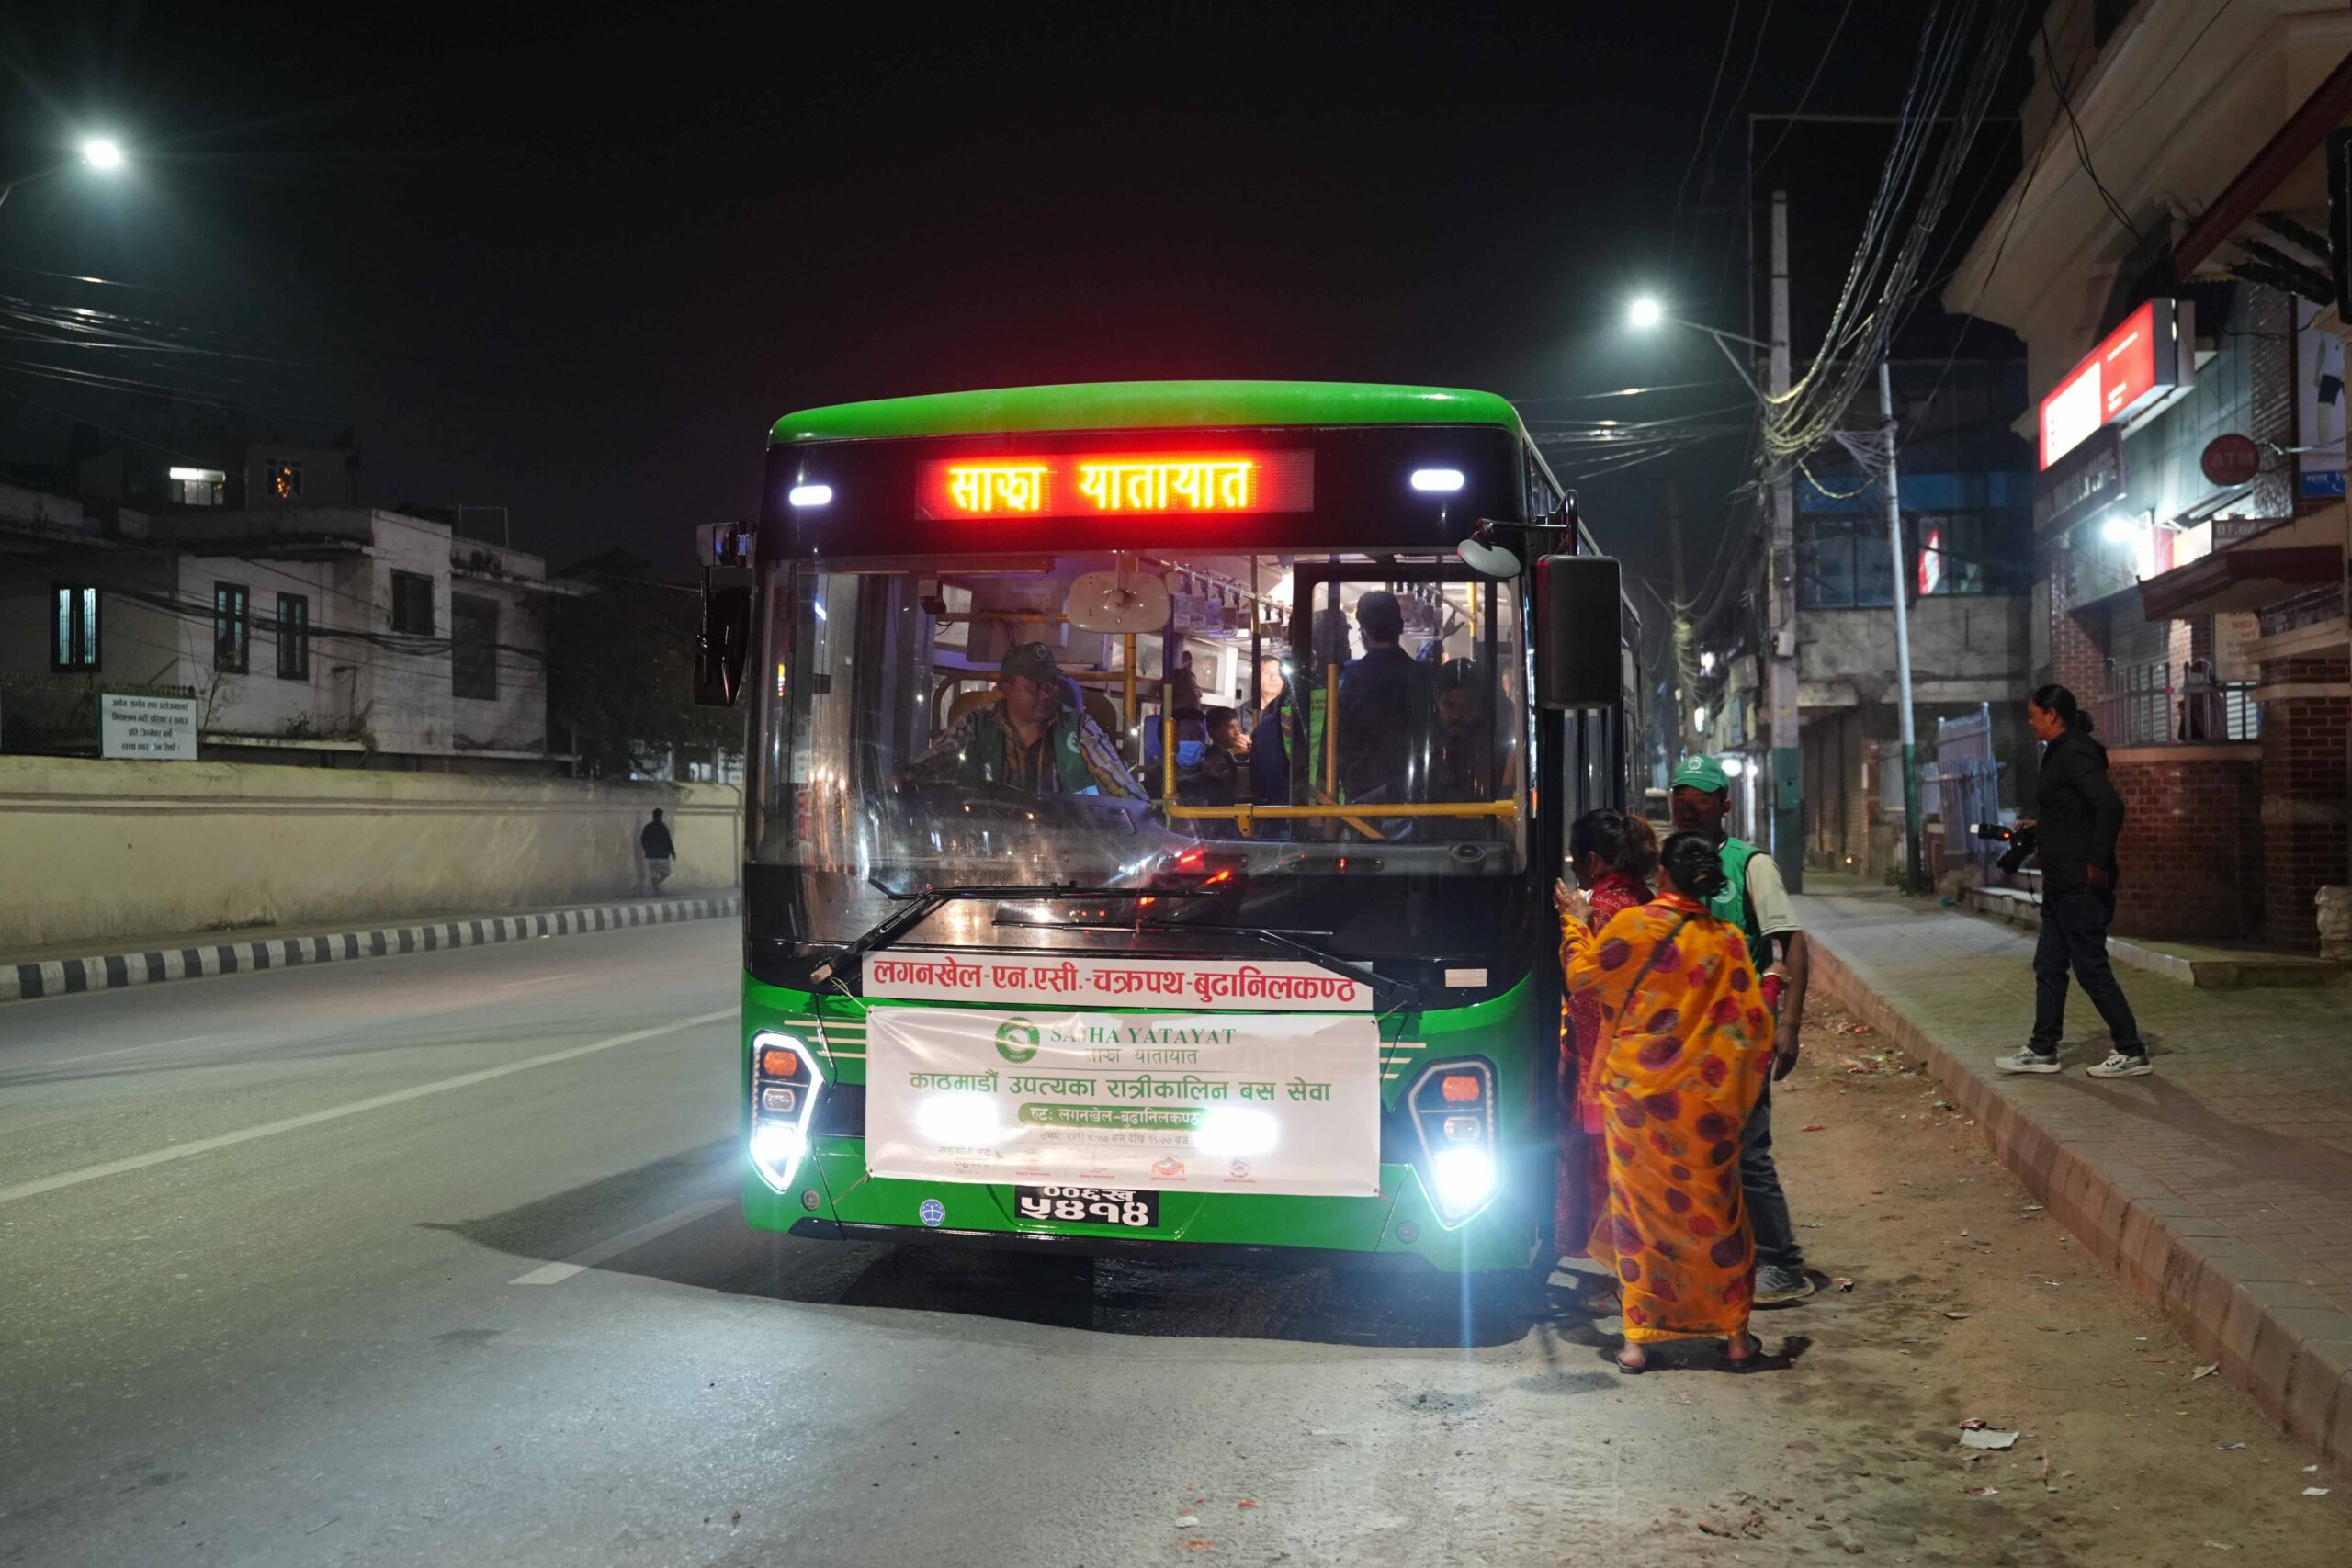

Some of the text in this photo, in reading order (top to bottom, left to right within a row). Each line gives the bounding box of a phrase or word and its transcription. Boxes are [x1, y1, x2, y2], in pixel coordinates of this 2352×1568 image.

[2212, 451, 2255, 467] ATM
[949, 461, 1254, 512] साझा यातायात
[1127, 1027, 1237, 1045] YATAYAT
[1134, 1049, 1199, 1065] यातायात
[909, 1068, 1332, 1101] काठमाडौं उपत्यका रात्रीकालिन बस सेवा
[1021, 1197, 1148, 1226] ५४१४
